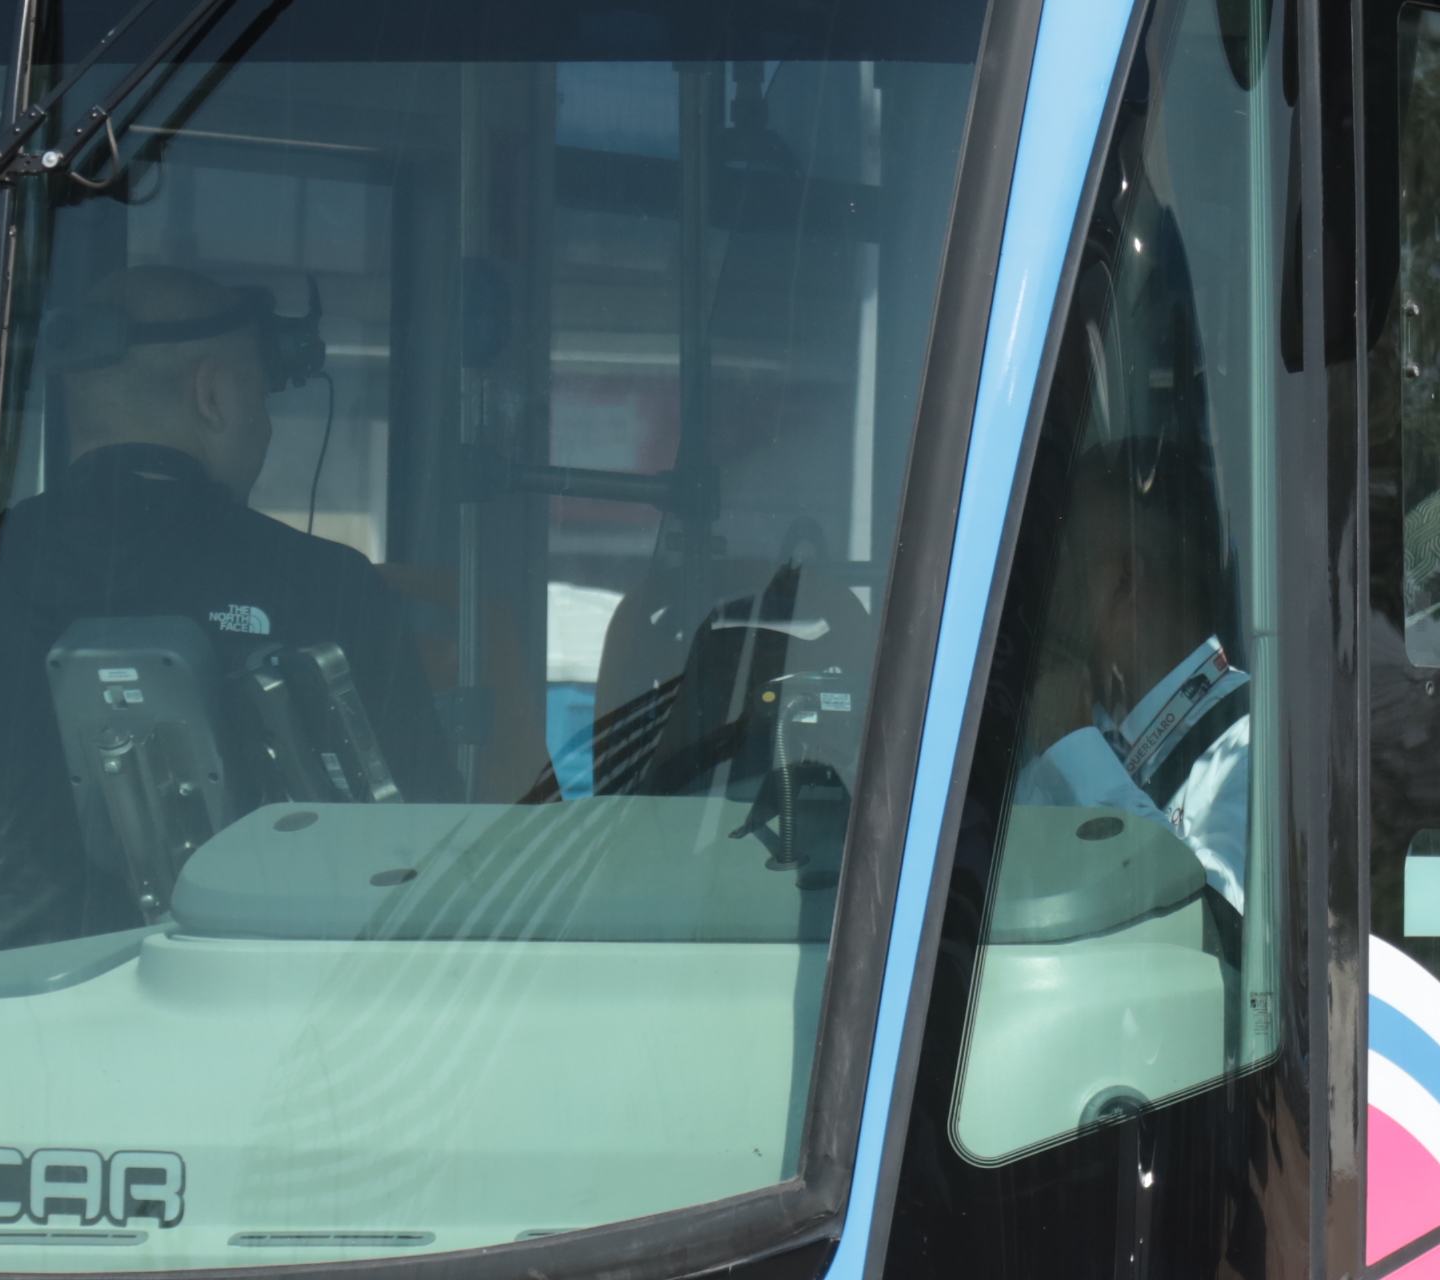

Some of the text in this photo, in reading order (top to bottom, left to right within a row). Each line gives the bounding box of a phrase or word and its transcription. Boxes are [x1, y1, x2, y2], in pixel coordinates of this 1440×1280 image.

[228, 604, 250, 615] THE
[209, 612, 249, 624] NORTH
[220, 621, 249, 632] FACE
